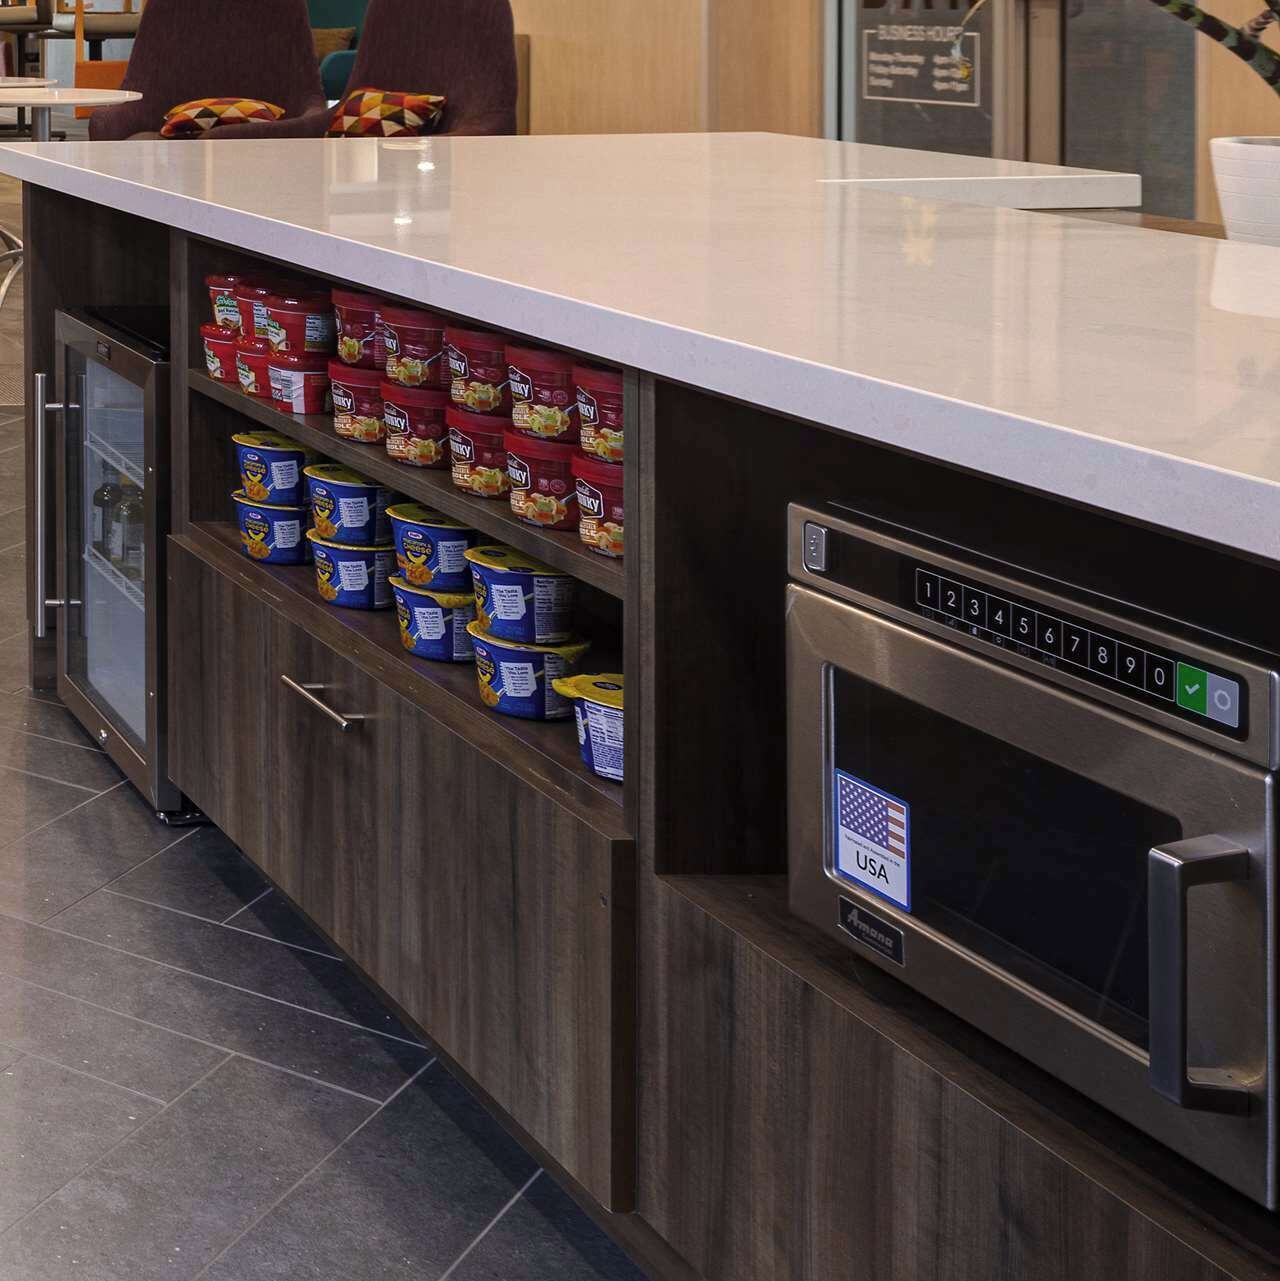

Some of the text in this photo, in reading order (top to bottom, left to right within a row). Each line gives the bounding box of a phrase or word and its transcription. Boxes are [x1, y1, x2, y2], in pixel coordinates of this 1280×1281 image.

[878, 24, 925, 41] BUSINESS
[925, 582, 932, 598] 1
[946, 591, 957, 607] 2
[970, 599, 979, 616] 3
[994, 609, 1004, 625] 4
[1019, 617, 1029, 635] 5
[1045, 627, 1054, 644] 6
[1071, 636, 1080, 652] 7
[1097, 646, 1108, 664] 8
[1126, 656, 1136, 674] 9
[1154, 667, 1166, 686] 0
[856, 850, 889, 884] USA
[848, 908, 893, 948] Amana
